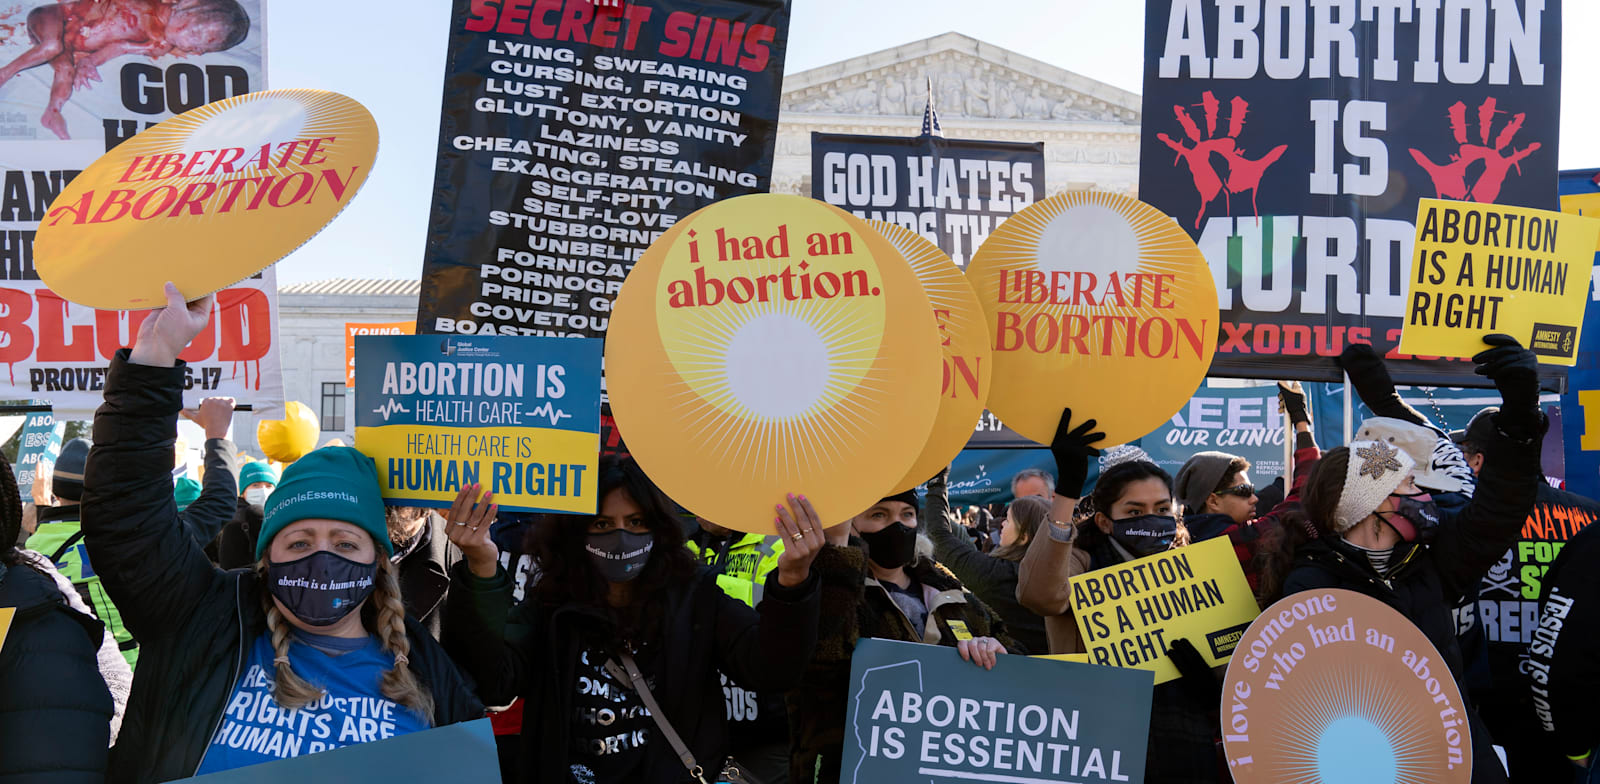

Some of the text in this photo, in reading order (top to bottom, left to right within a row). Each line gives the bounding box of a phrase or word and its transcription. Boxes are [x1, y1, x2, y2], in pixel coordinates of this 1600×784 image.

[465, 0, 776, 73] SECRET SINS
[1158, 0, 1546, 85] ABORTION
[488, 39, 747, 91] LYING, SWEARING
[491, 60, 741, 106] CURSING, FRAUD
[120, 63, 249, 115] GOD
[486, 78, 741, 126] LUST, EXTORTION
[475, 97, 748, 148] GLUTTONY, VANITY
[540, 125, 680, 155] LAZINESS
[117, 136, 336, 184] LIBERATE
[453, 135, 758, 188] CHEATING, STEALING
[1309, 100, 1389, 197] IS
[48, 166, 360, 226] ABORTION
[491, 157, 716, 199] EXAGGERATION
[531, 181, 674, 210] SELF-PITY
[823, 152, 1034, 213] GOD HATES
[522, 198, 678, 228] SELF-LOVE
[1420, 207, 1559, 254] ABORTION
[497, 248, 633, 278] FORNICA
[688, 224, 853, 263] i had an
[667, 260, 880, 308] abortion.
[998, 269, 1176, 310] LIBERATE
[1417, 249, 1445, 285] IS
[1456, 254, 1474, 287] A
[1485, 256, 1568, 296] HUMAN
[481, 282, 579, 311] PRIDE,
[1410, 291, 1504, 331] RIGHT
[992, 311, 1208, 361] BORTION
[1215, 322, 1371, 357] XODUS
[1535, 330, 1561, 342] AMNESTY
[30, 368, 108, 391] PROVE
[382, 362, 524, 397] ABORTION
[536, 364, 566, 399] IS
[416, 400, 522, 424] HEALTH CARE
[407, 433, 532, 458] HEALTH CARE IS
[1166, 427, 1287, 447] OUR CLINIC
[388, 457, 587, 497] HUMAN RIGHT
[311, 579, 318, 589] is
[320, 582, 327, 590] a
[1073, 553, 1194, 610] ABORTION
[1082, 578, 1224, 642] IS A HUMAN
[1243, 592, 1337, 672] someone
[1094, 629, 1172, 668] RIGHT
[226, 691, 332, 738] RIGHTS
[871, 689, 1079, 741] ABORTION
[1226, 680, 1251, 743] love
[1264, 617, 1464, 771] who had an abortion.
[214, 719, 303, 758] HUMAN
[339, 716, 397, 742] ARE
[869, 726, 1130, 783] IS ESSENTIAL
[1230, 755, 1254, 767] i
